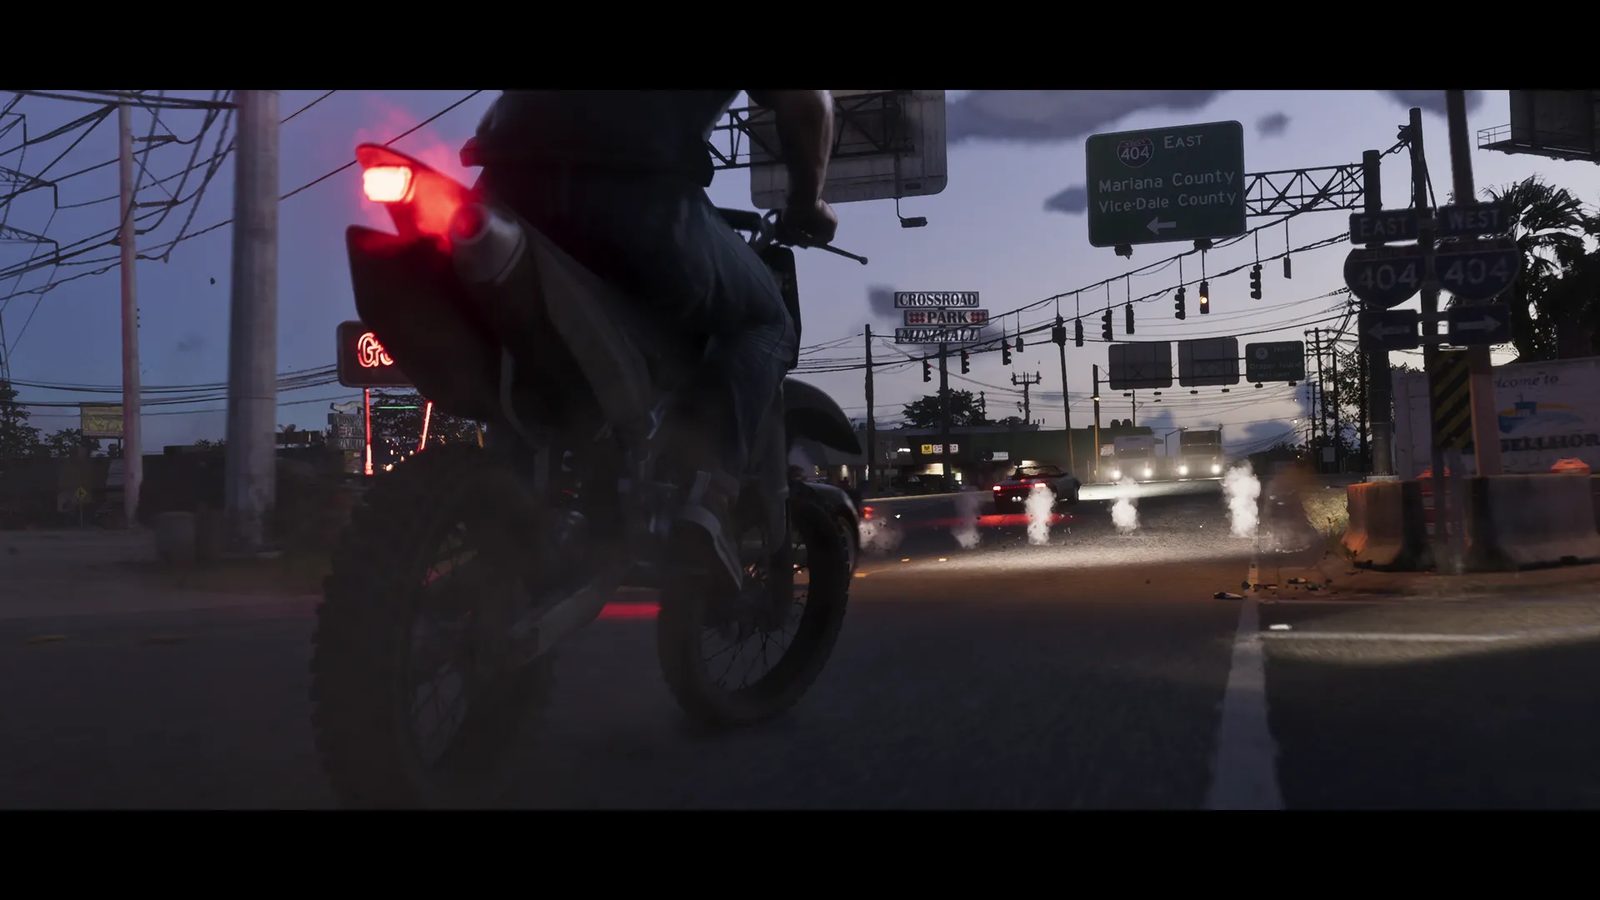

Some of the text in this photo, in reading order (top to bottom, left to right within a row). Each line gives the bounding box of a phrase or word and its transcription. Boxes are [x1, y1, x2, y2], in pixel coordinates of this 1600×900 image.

[1164, 135, 1203, 149] EAST
[1120, 146, 1150, 161] 404
[1099, 169, 1235, 193] Mariana County
[1178, 192, 1236, 206] County
[1359, 217, 1408, 237] EAST
[1449, 209, 1500, 230] WEST
[1359, 262, 1420, 291] 404
[1443, 257, 1513, 286] 404
[900, 293, 977, 306] CROSSROAD
[927, 311, 968, 323] PARK
[1494, 374, 1560, 388] lcome to
